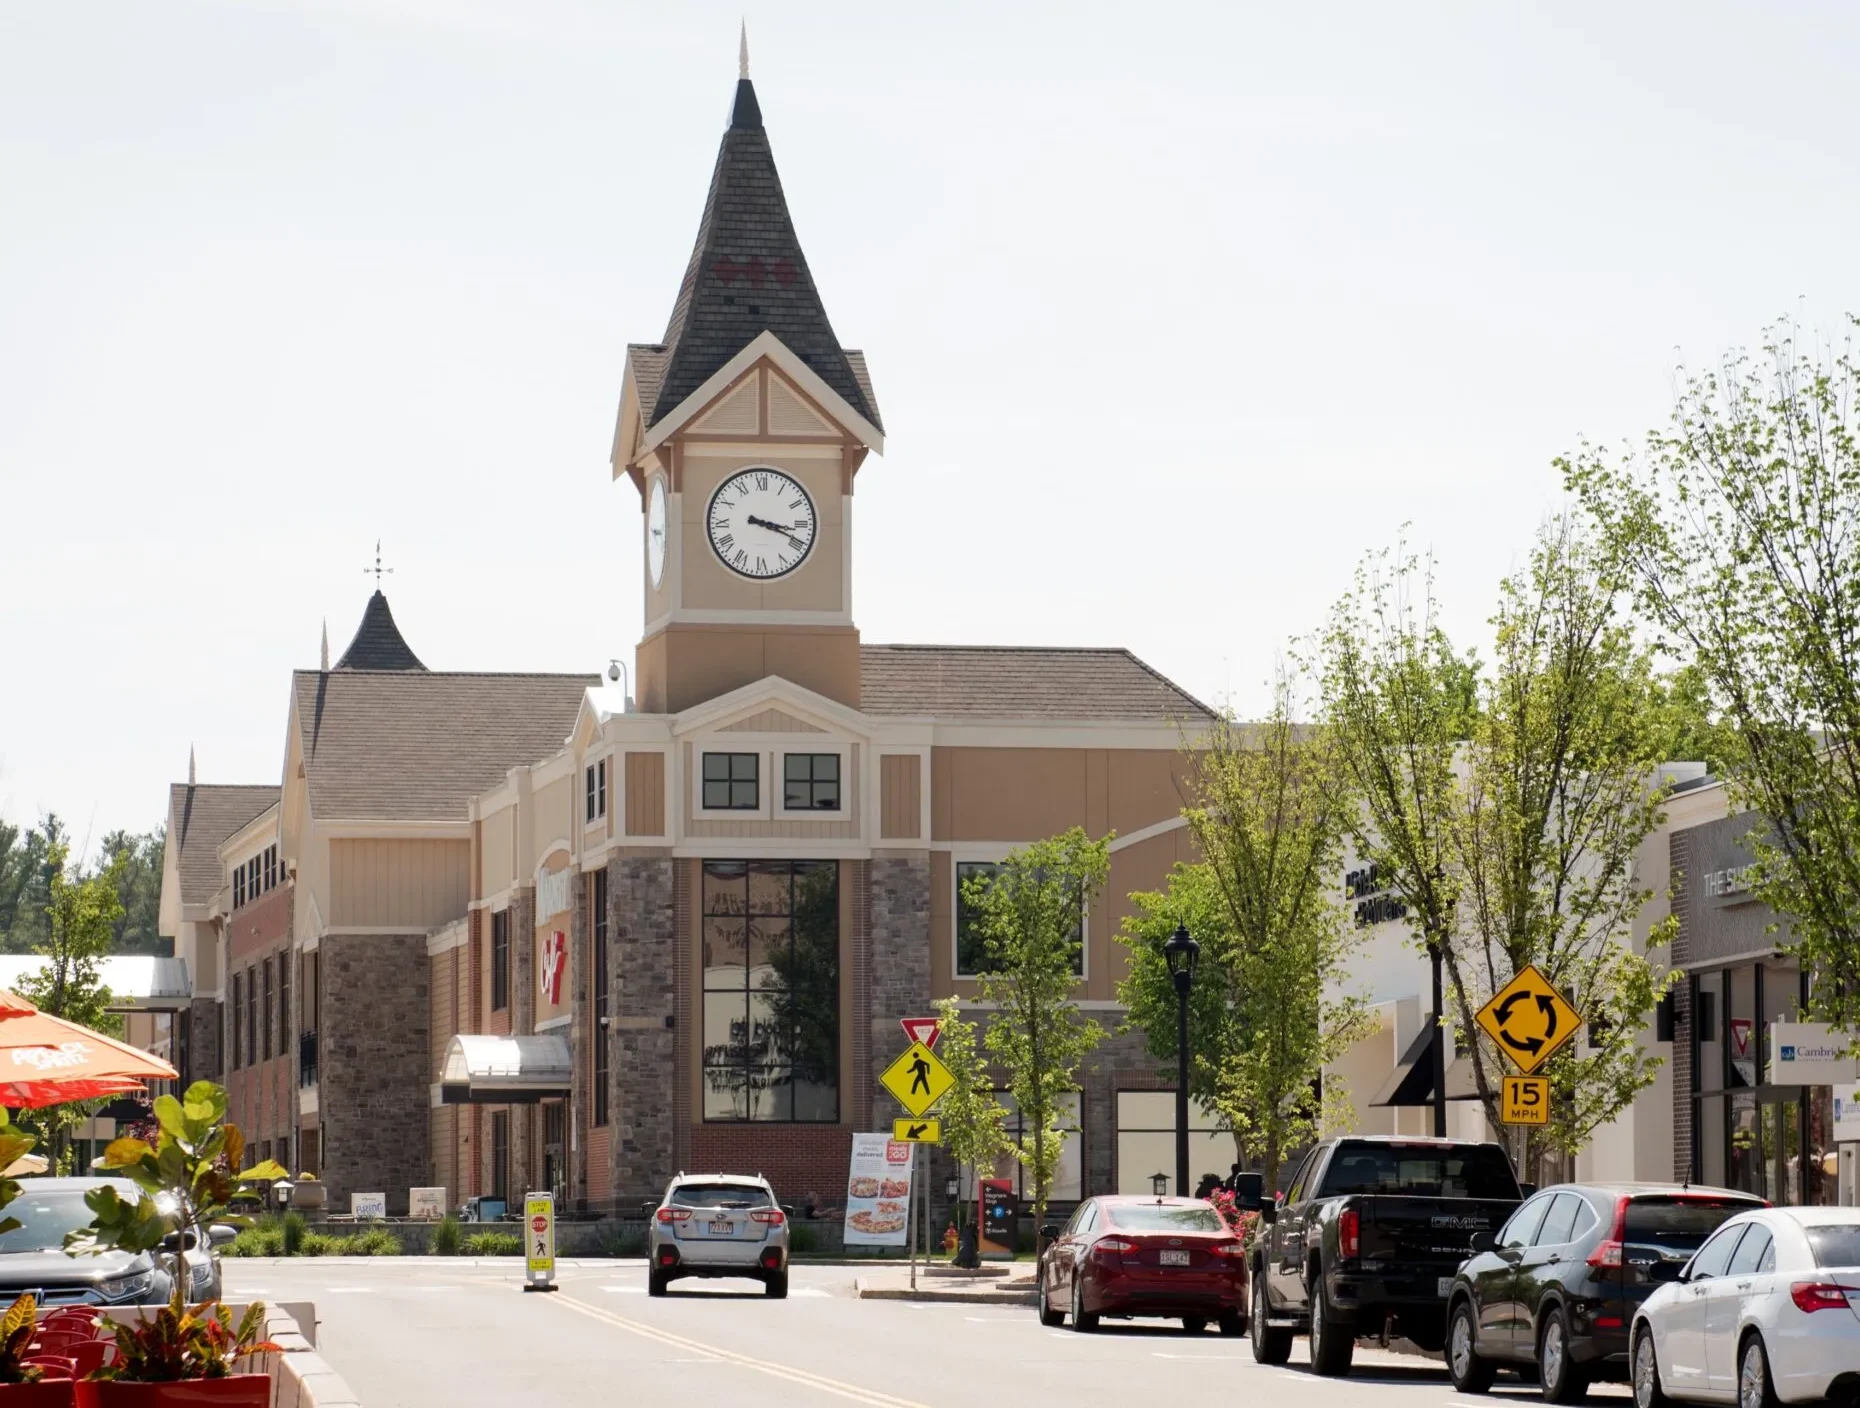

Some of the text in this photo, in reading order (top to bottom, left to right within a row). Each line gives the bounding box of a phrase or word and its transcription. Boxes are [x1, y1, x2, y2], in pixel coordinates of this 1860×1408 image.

[756, 477, 768, 491] XII
[789, 500, 802, 510] II
[794, 520, 808, 528] III
[1704, 871, 1724, 897] THE
[1797, 1046, 1846, 1058] Cambri
[1511, 1082, 1540, 1106] 15
[1511, 1109, 1539, 1119] MPH
[996, 1208, 1002, 1218] P
[531, 1220, 548, 1229] STOP
[1431, 1216, 1490, 1229] GMC
